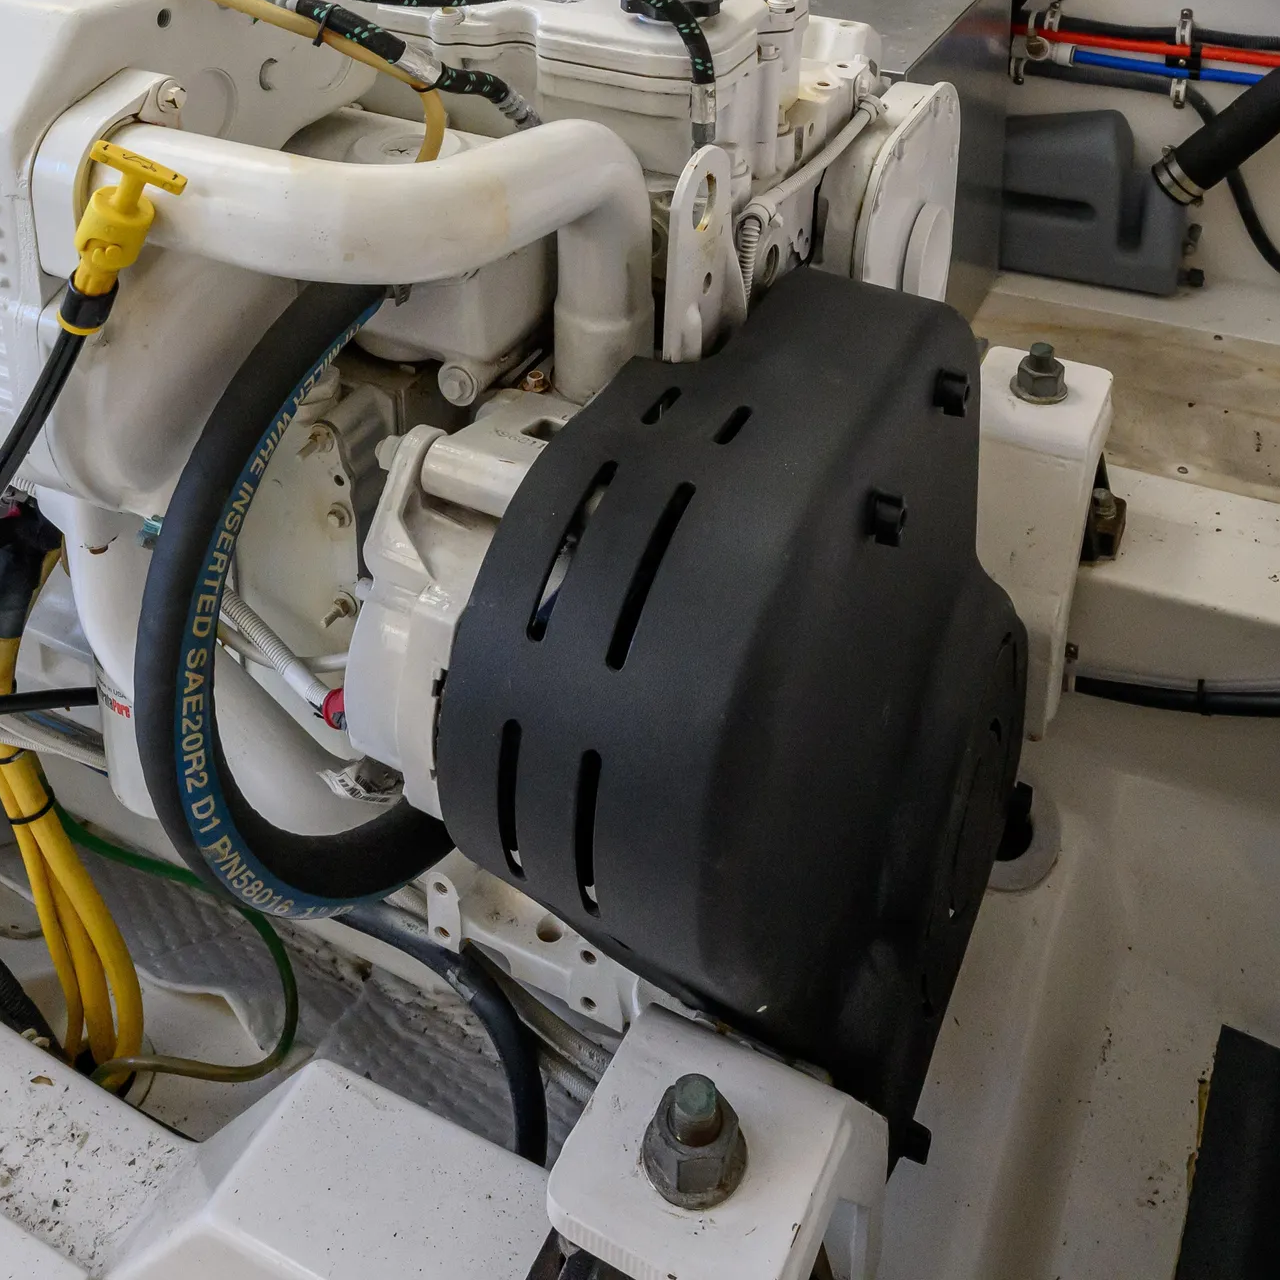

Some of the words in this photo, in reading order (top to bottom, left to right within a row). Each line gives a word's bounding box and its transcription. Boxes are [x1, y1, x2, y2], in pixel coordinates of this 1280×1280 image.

[249, 410, 294, 478] WIRE
[192, 481, 253, 637] INSERTED
[181, 648, 207, 794] SAE20R2
[191, 794, 220, 833] D1
